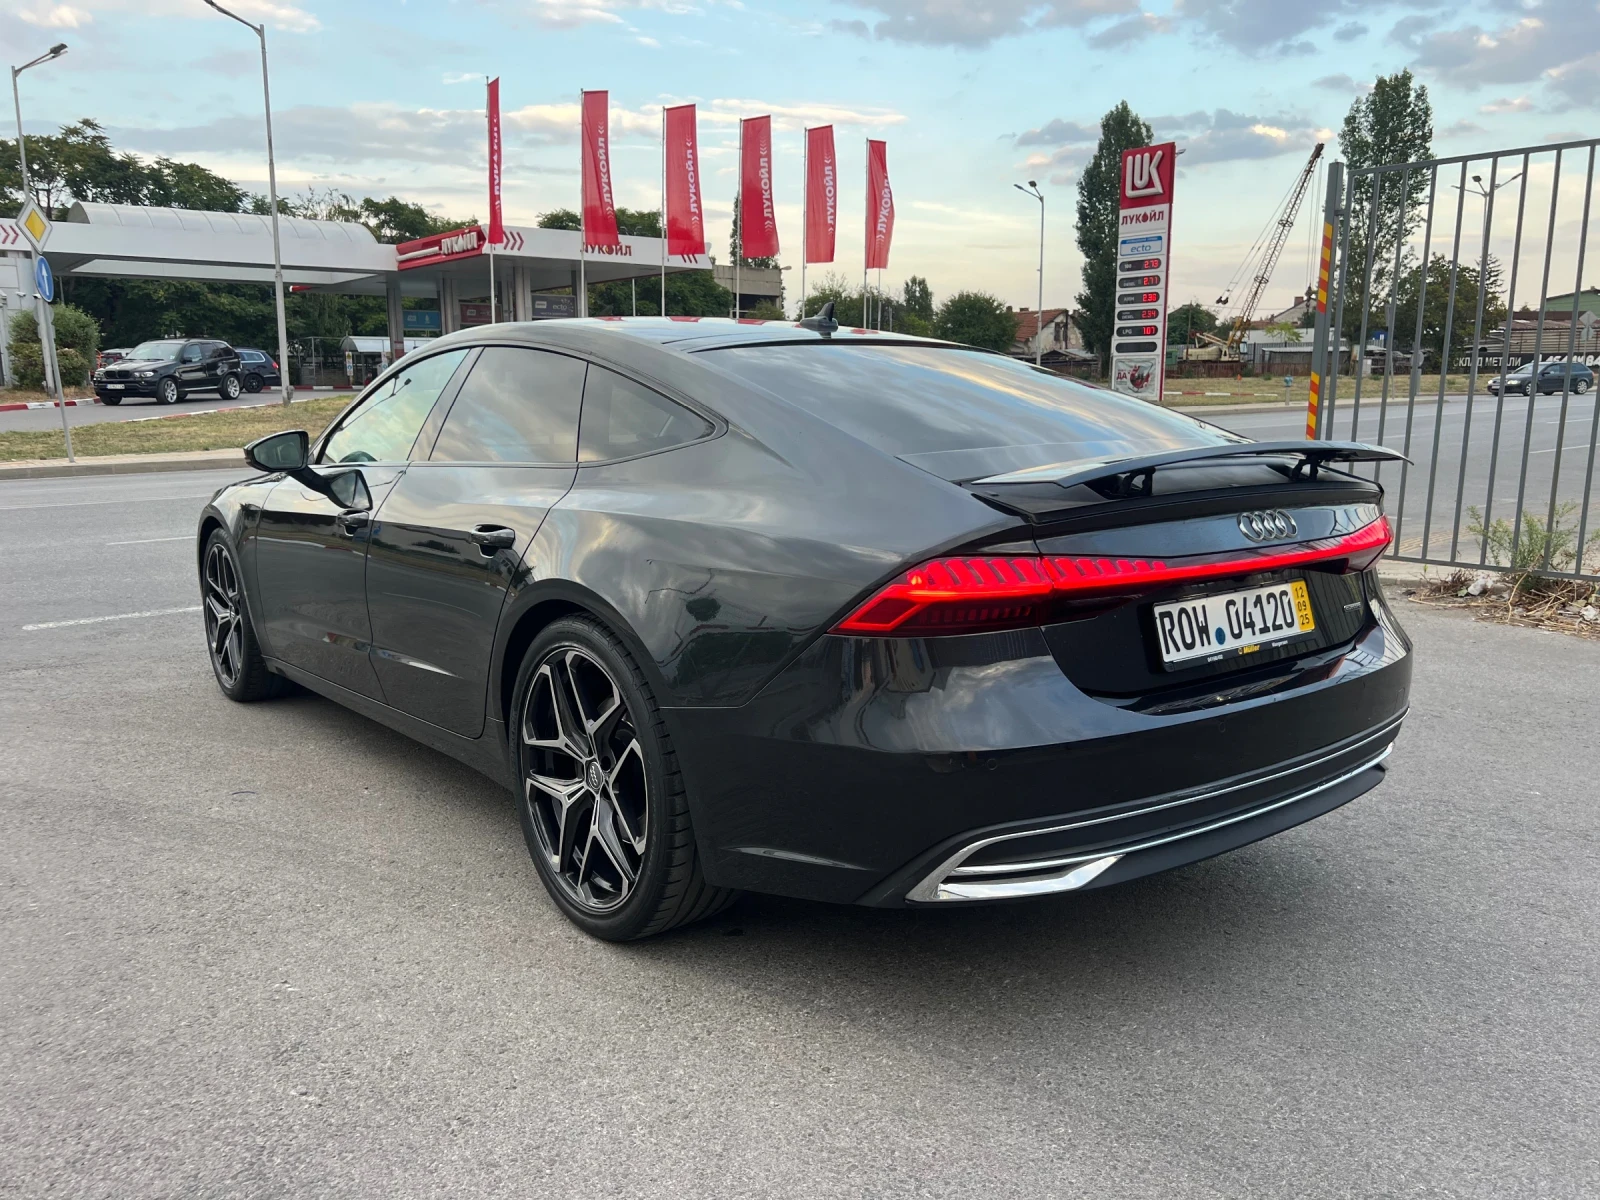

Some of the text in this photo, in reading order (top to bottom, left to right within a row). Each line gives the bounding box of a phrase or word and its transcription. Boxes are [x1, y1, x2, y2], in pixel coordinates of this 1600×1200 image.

[598, 138, 611, 204] ЛУКОЙЛ
[686, 149, 698, 214] ЛУКОЙЛ
[759, 157, 772, 218] ЛУКОЙЛ
[824, 166, 834, 224] ЛУКОЙЛ
[1130, 244, 1151, 253] ecto
[1485, 356, 1522, 367] МЕТЛИ
[1295, 587, 1305, 598] 12
[1297, 601, 1307, 611] 09
[1159, 590, 1295, 655] ROW 04120
[1300, 614, 1310, 626] 25
